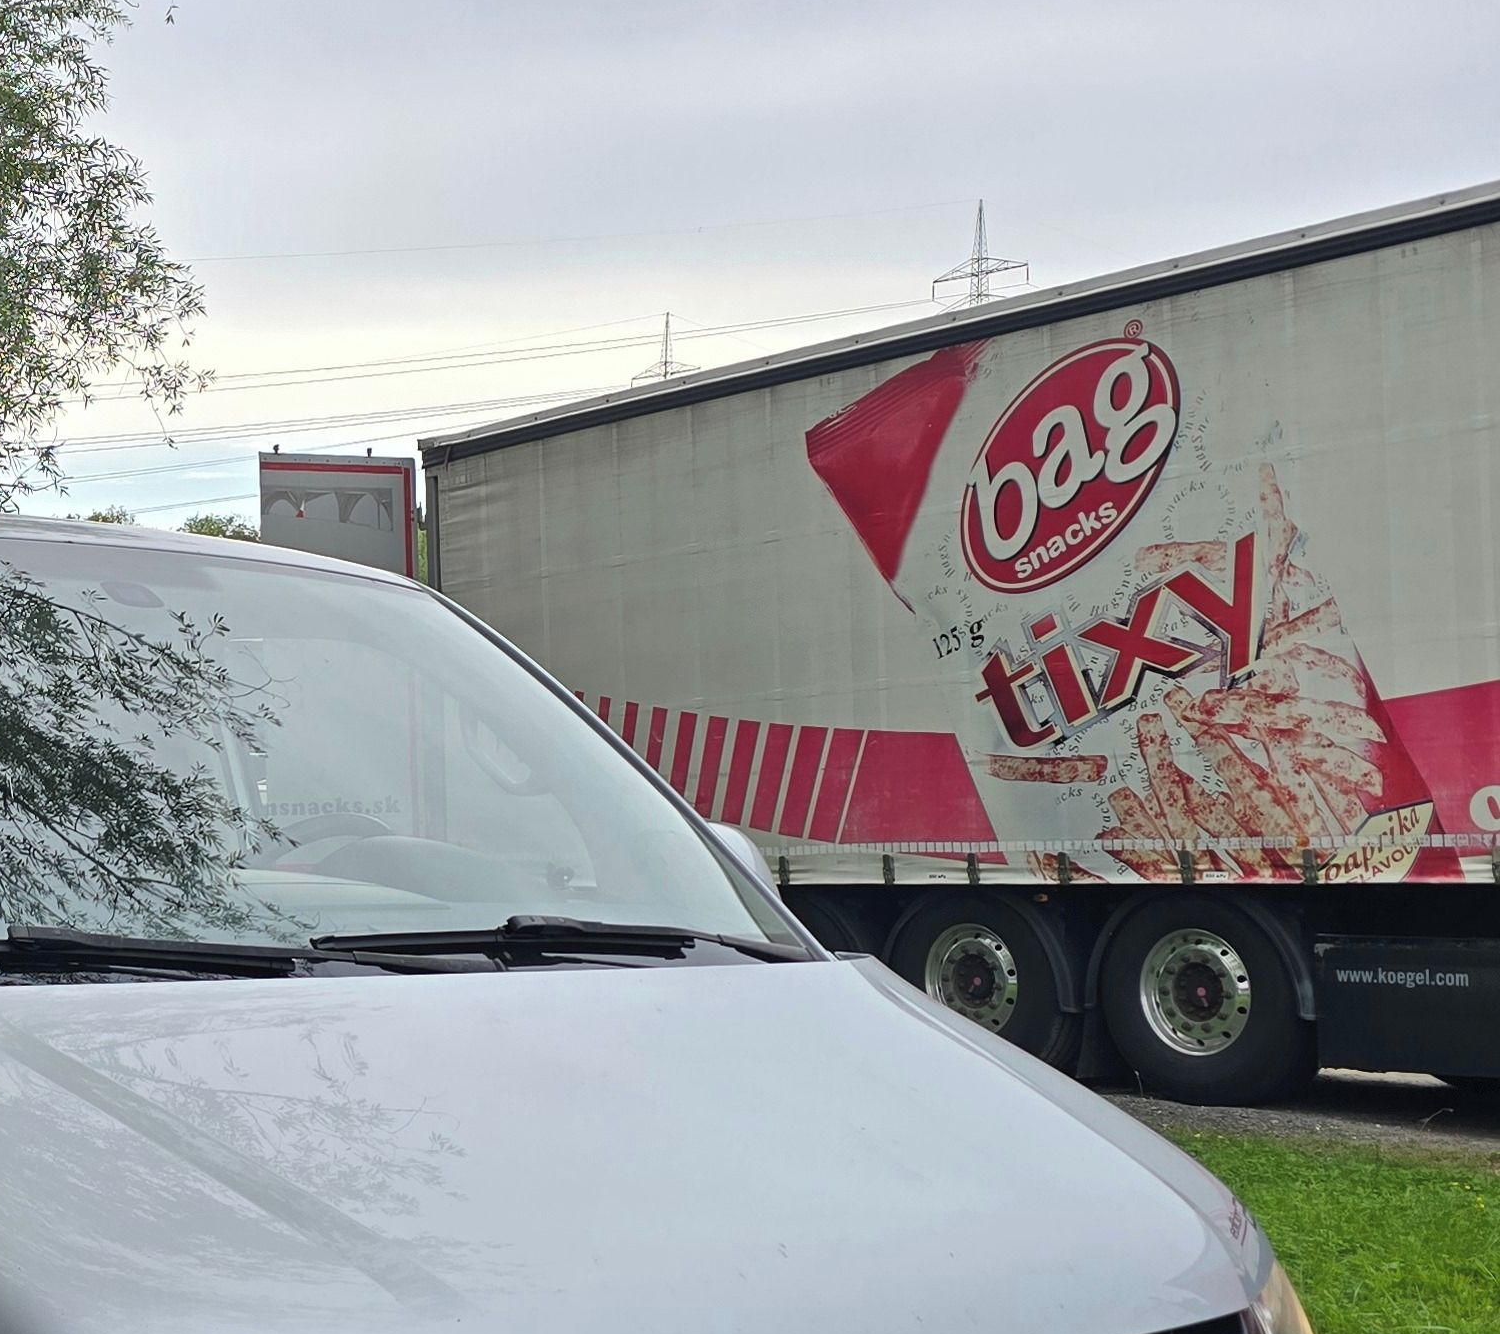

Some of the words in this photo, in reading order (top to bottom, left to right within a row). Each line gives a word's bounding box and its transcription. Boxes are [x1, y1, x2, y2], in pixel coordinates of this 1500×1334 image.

[967, 341, 1176, 561] bag
[1014, 501, 1118, 579] snacks
[932, 625, 962, 660] 125
[968, 617, 985, 649] g
[974, 532, 1257, 749] tixy
[1335, 967, 1470, 989] www.koegel.com
